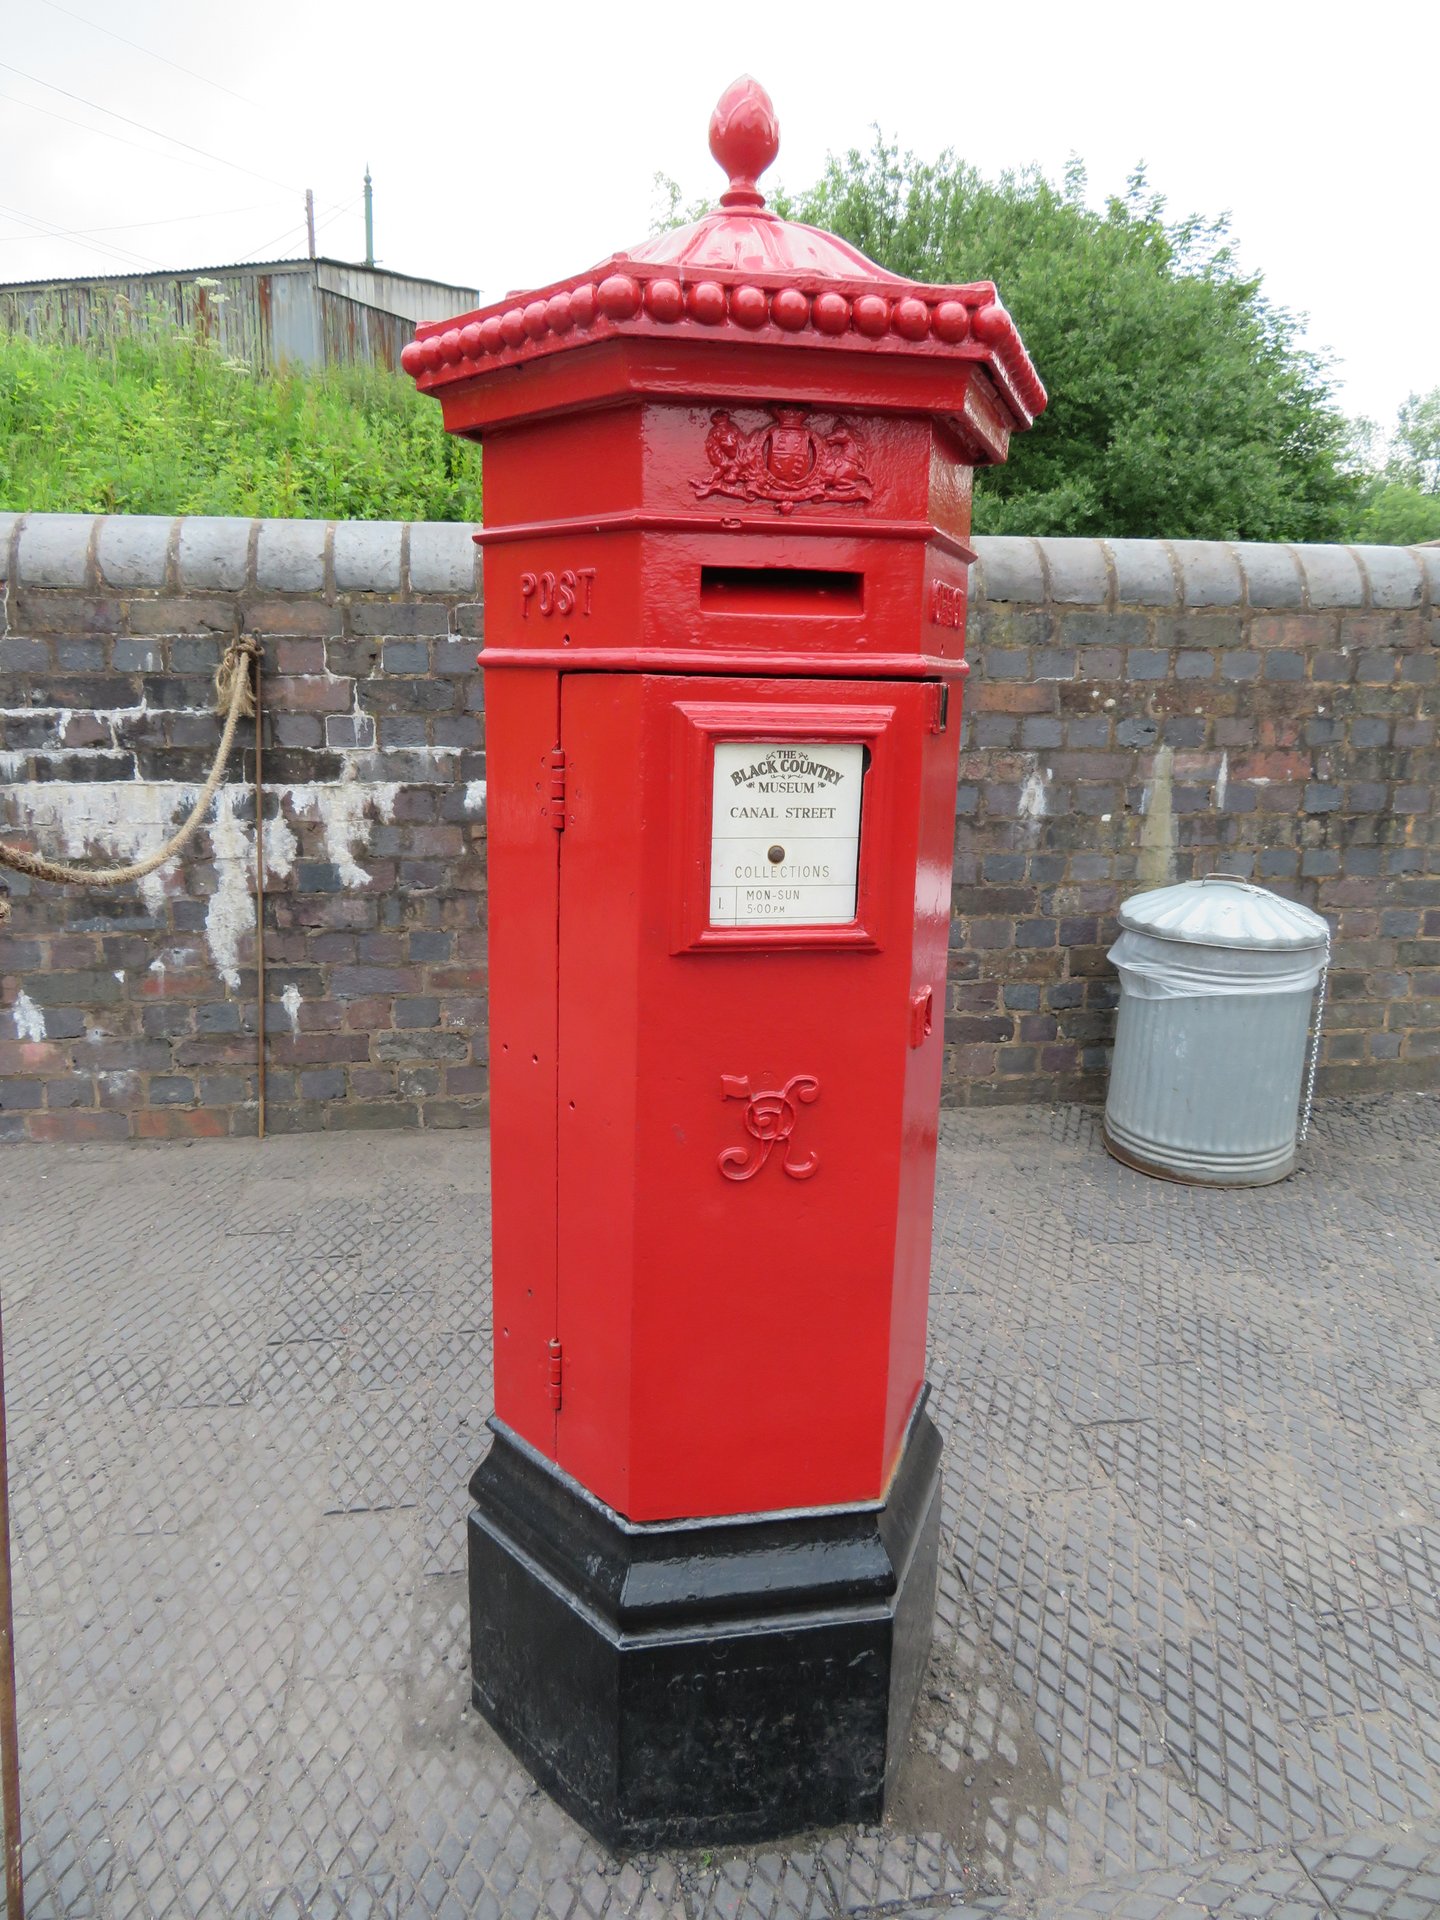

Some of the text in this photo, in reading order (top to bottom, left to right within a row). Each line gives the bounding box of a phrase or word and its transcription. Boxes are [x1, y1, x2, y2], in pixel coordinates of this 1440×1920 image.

[520, 568, 597, 618] POST
[777, 750, 797, 759] THE
[730, 759, 844, 786] BLACK COUNTRY
[758, 782, 815, 793] MUSEUM
[730, 807, 836, 819] CANAL STREET
[735, 865, 830, 879] COLLECTIONS
[746, 889, 800, 901] MON-SUN
